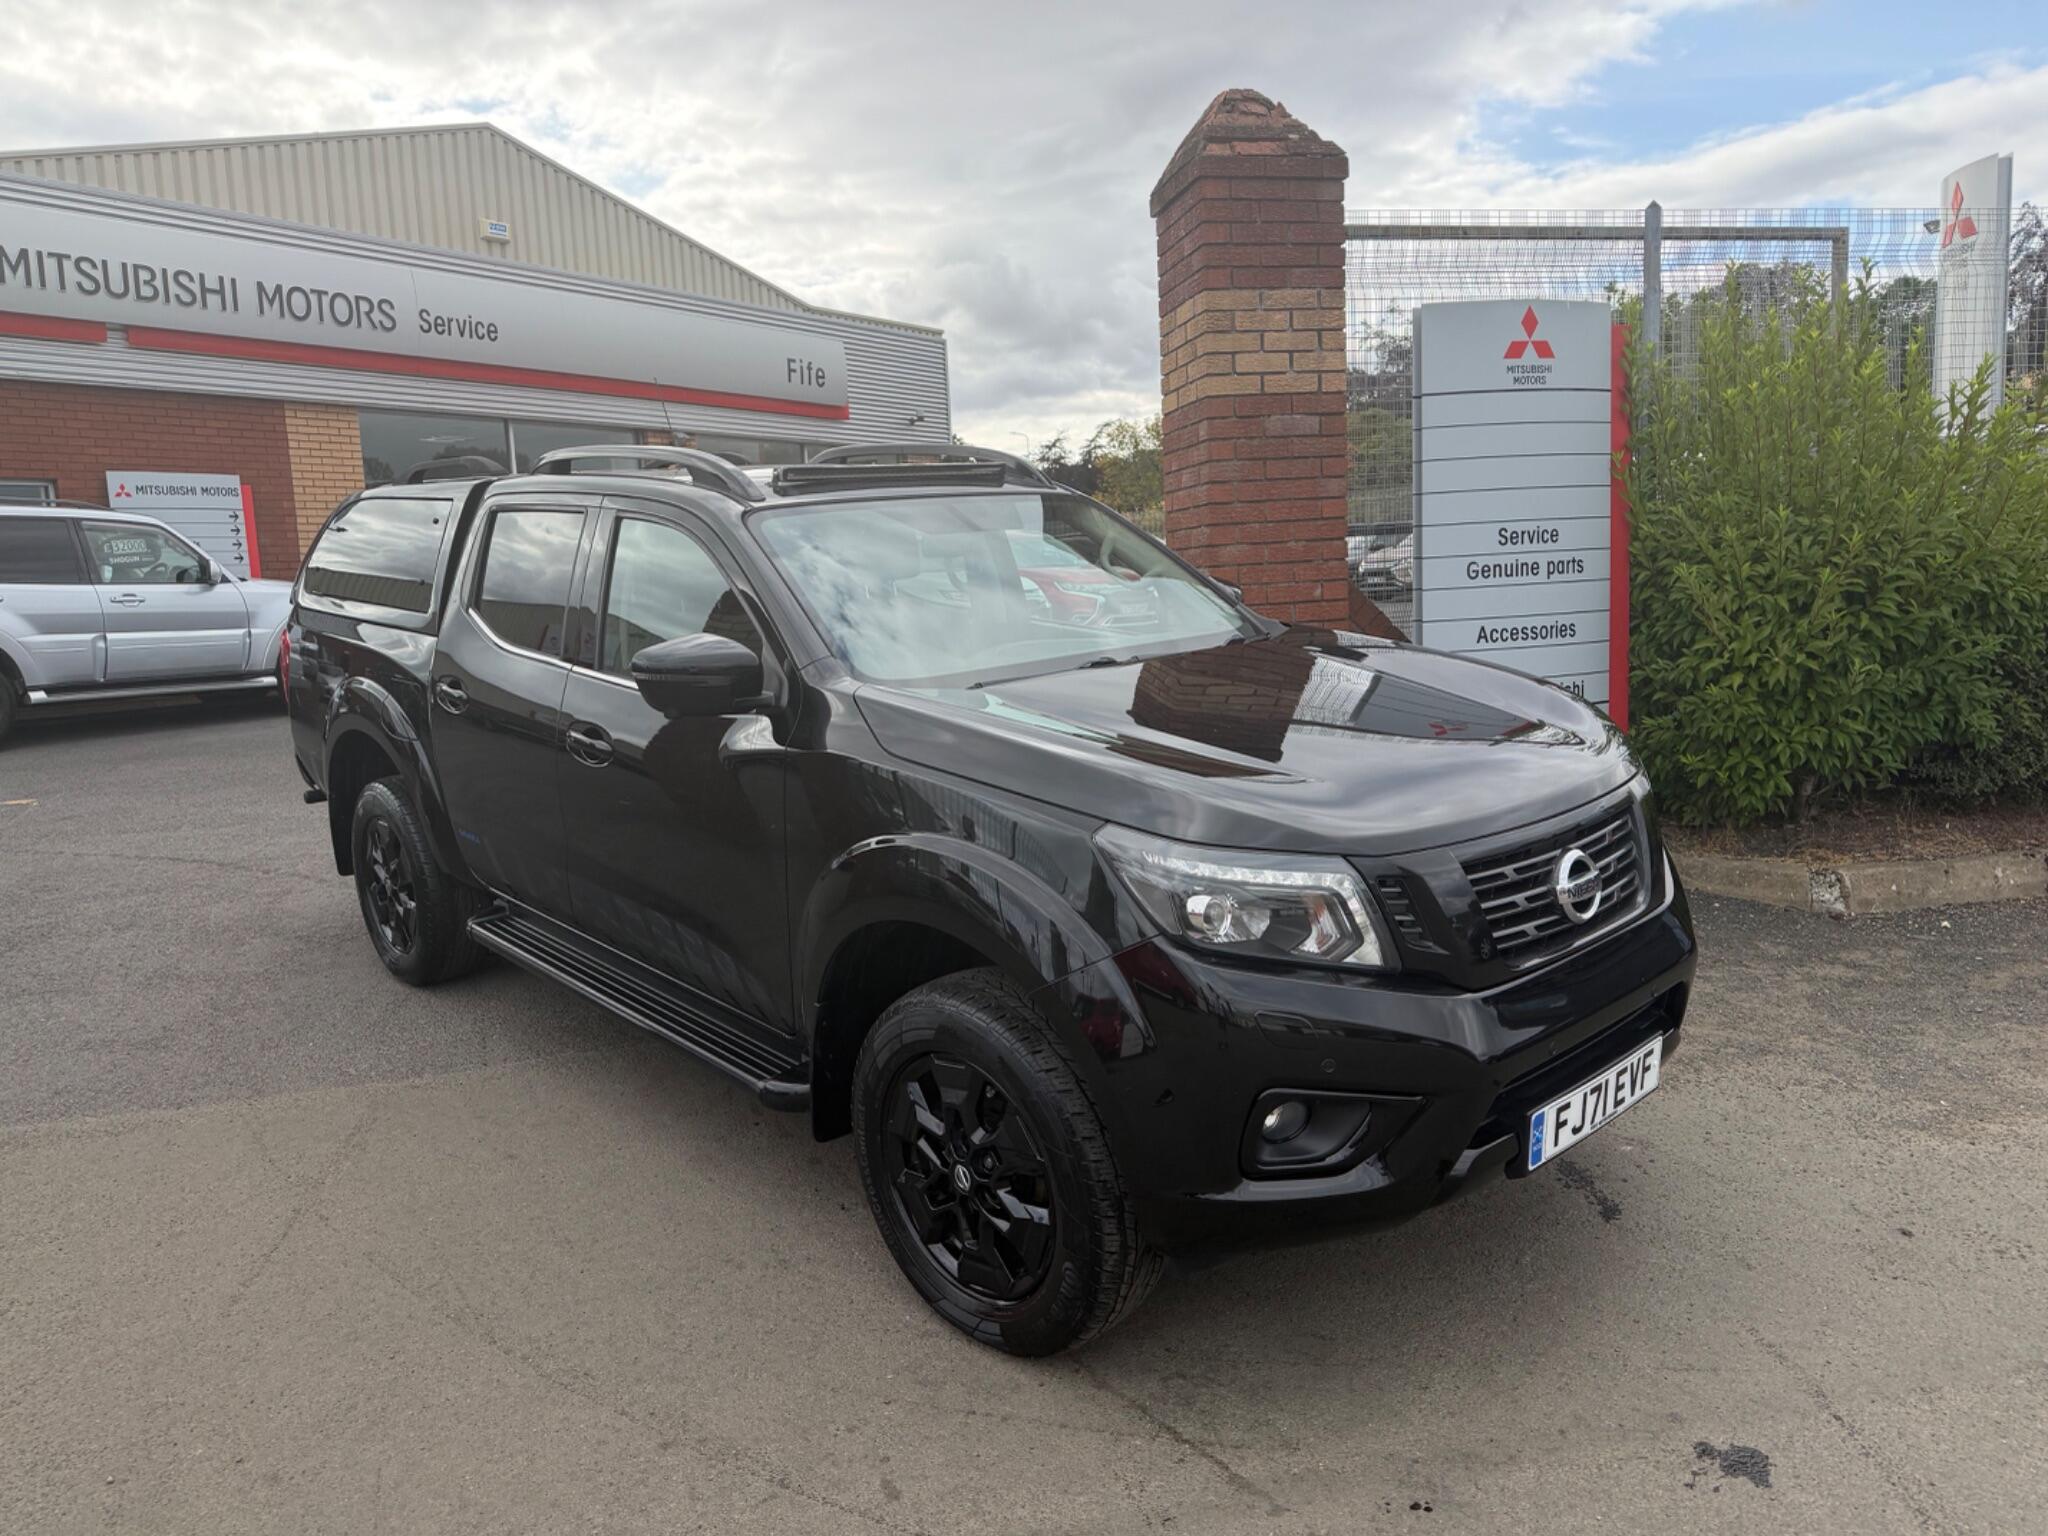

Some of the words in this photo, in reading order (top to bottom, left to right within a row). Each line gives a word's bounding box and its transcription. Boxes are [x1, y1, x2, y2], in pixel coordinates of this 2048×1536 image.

[0, 245, 239, 313] MITSUBISHI
[256, 280, 397, 332] MOTORS
[418, 308, 499, 342] Service
[786, 358, 826, 388] Fife
[1506, 364, 1553, 374] MITSUBISHI
[1513, 375, 1547, 385] MOTORS
[135, 484, 198, 497] MITSUBISHI
[200, 486, 239, 497] MOTORS
[1498, 525, 1560, 546] Service
[1466, 558, 1540, 580] Genuine
[1546, 556, 1584, 580] parts
[1476, 620, 1577, 644] Accessories
[1613, 1047, 1654, 1110] EVF
